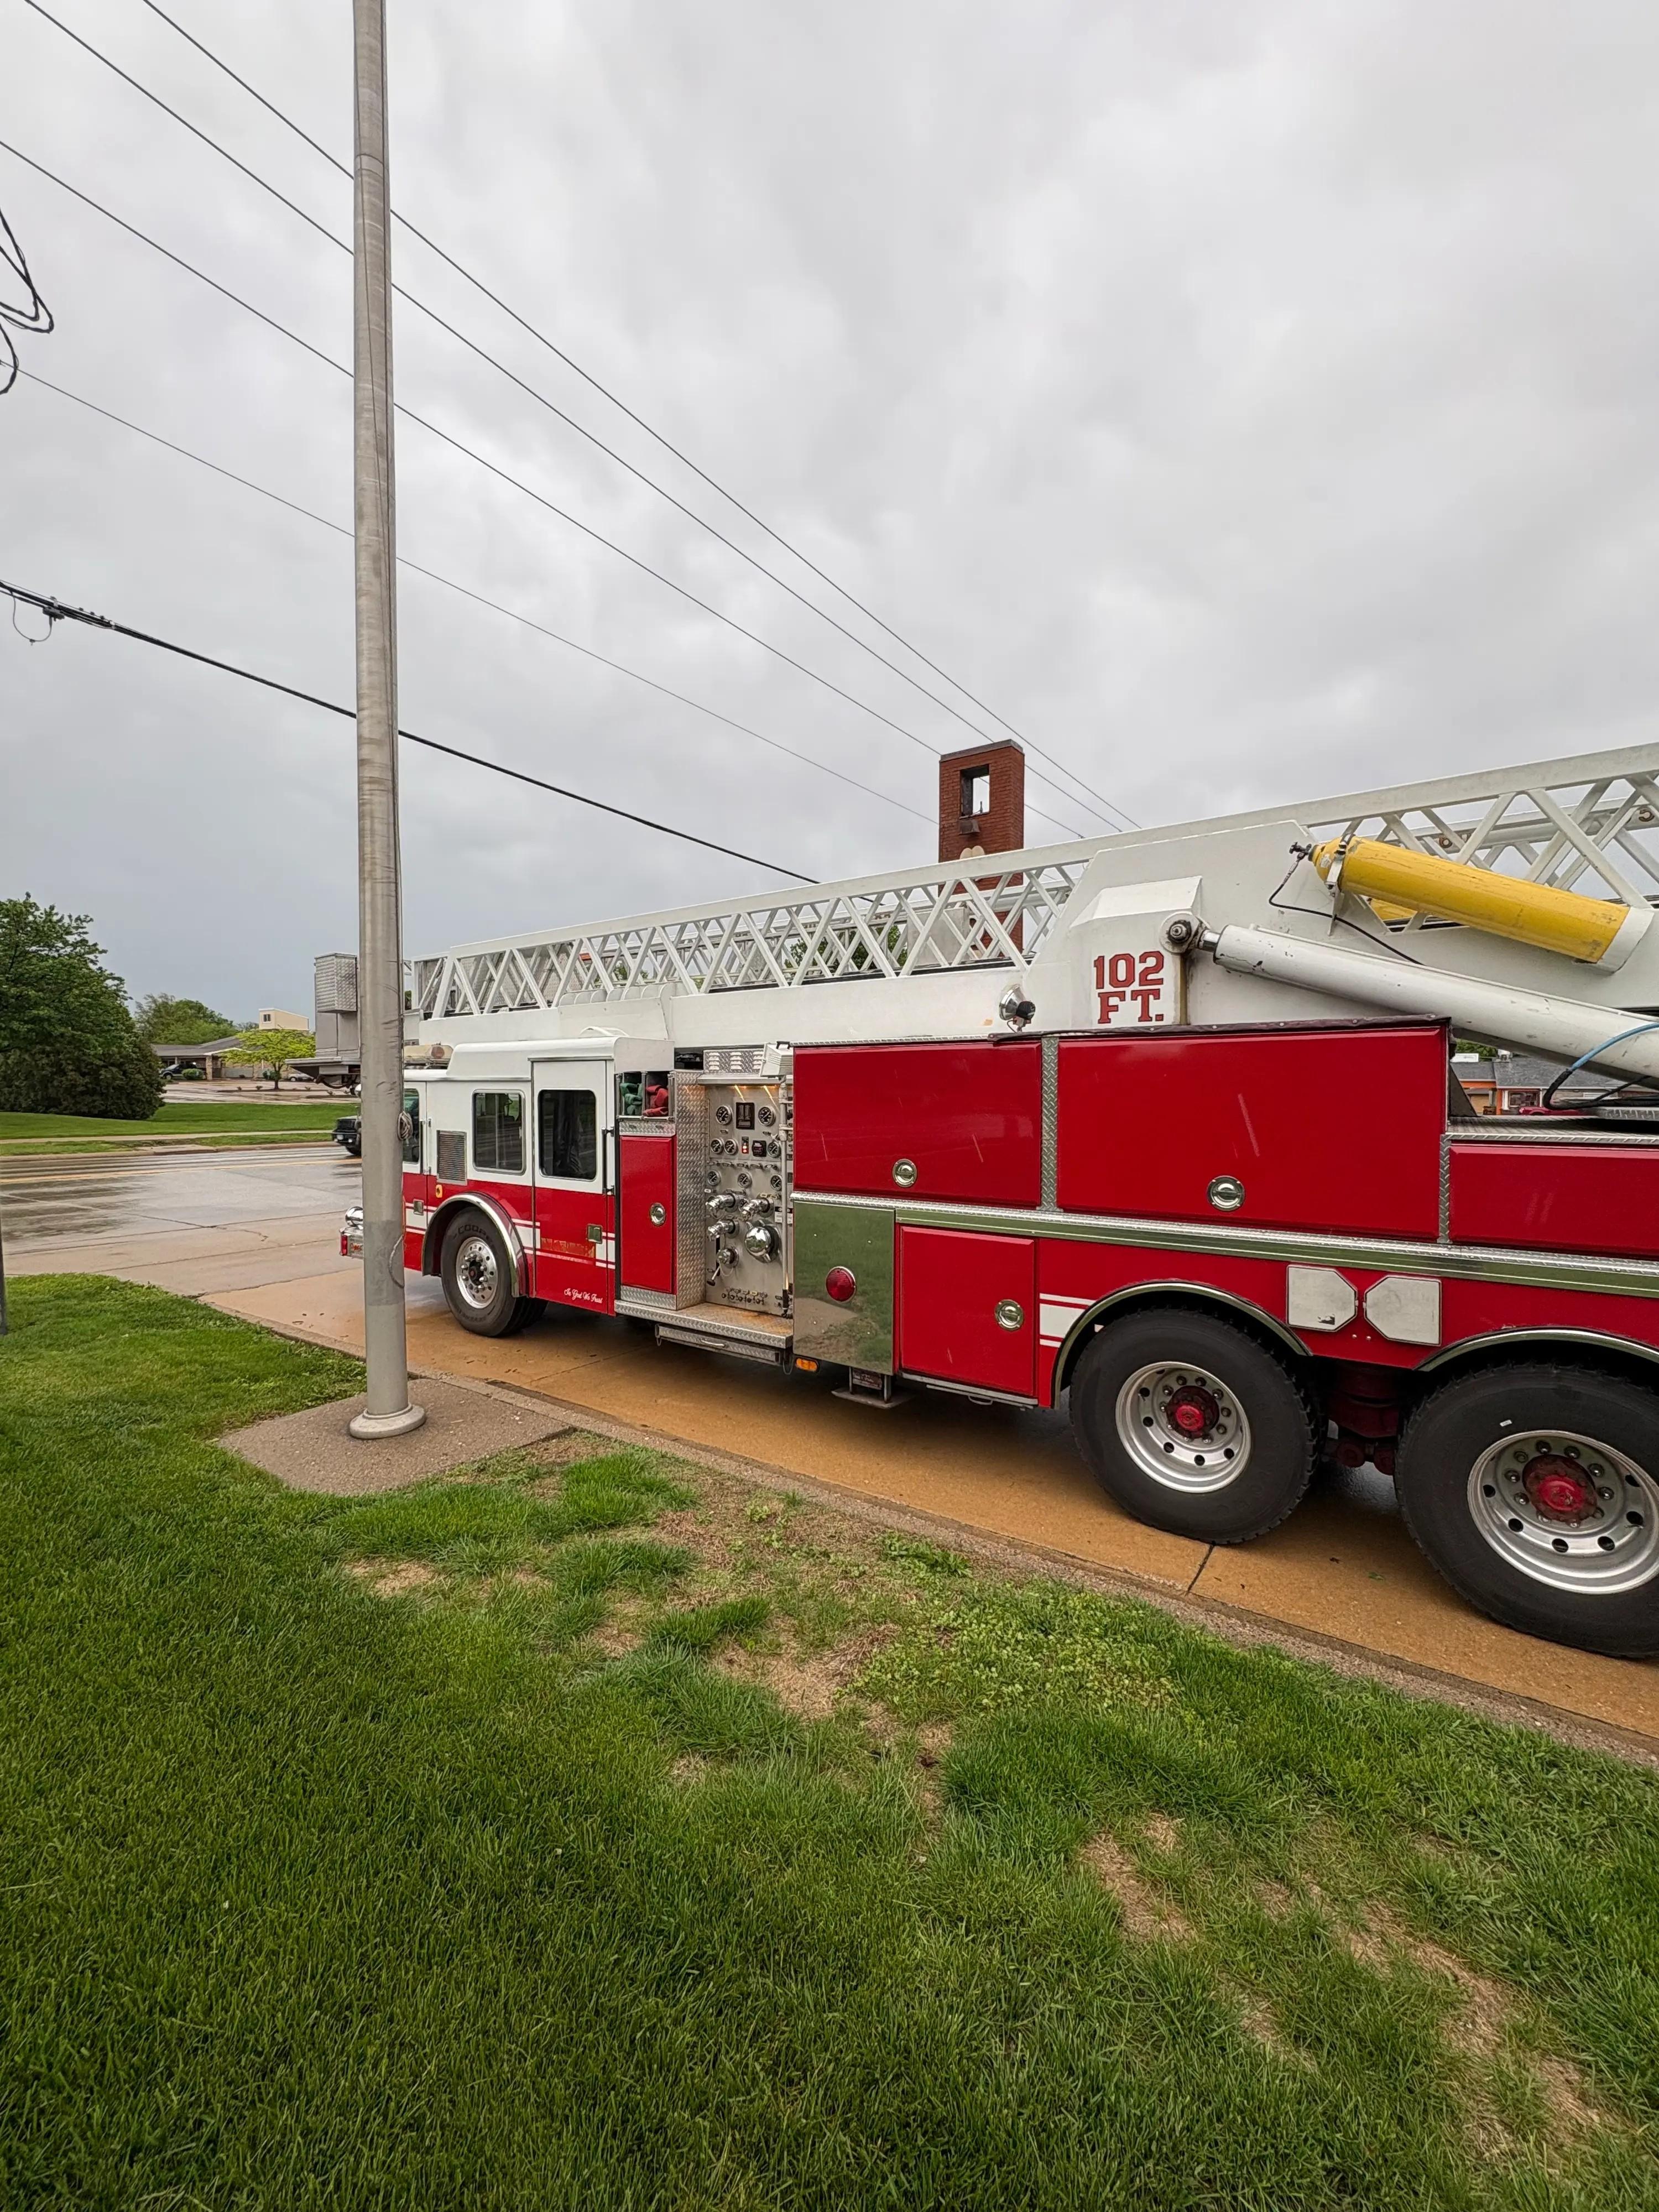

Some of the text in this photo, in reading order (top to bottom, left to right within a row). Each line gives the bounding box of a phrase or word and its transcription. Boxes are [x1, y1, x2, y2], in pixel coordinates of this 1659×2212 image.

[1093, 951, 1164, 989] 102
[1098, 988, 1164, 1024] FT.
[571, 1288, 583, 1300] God
[582, 1291, 591, 1300] We
